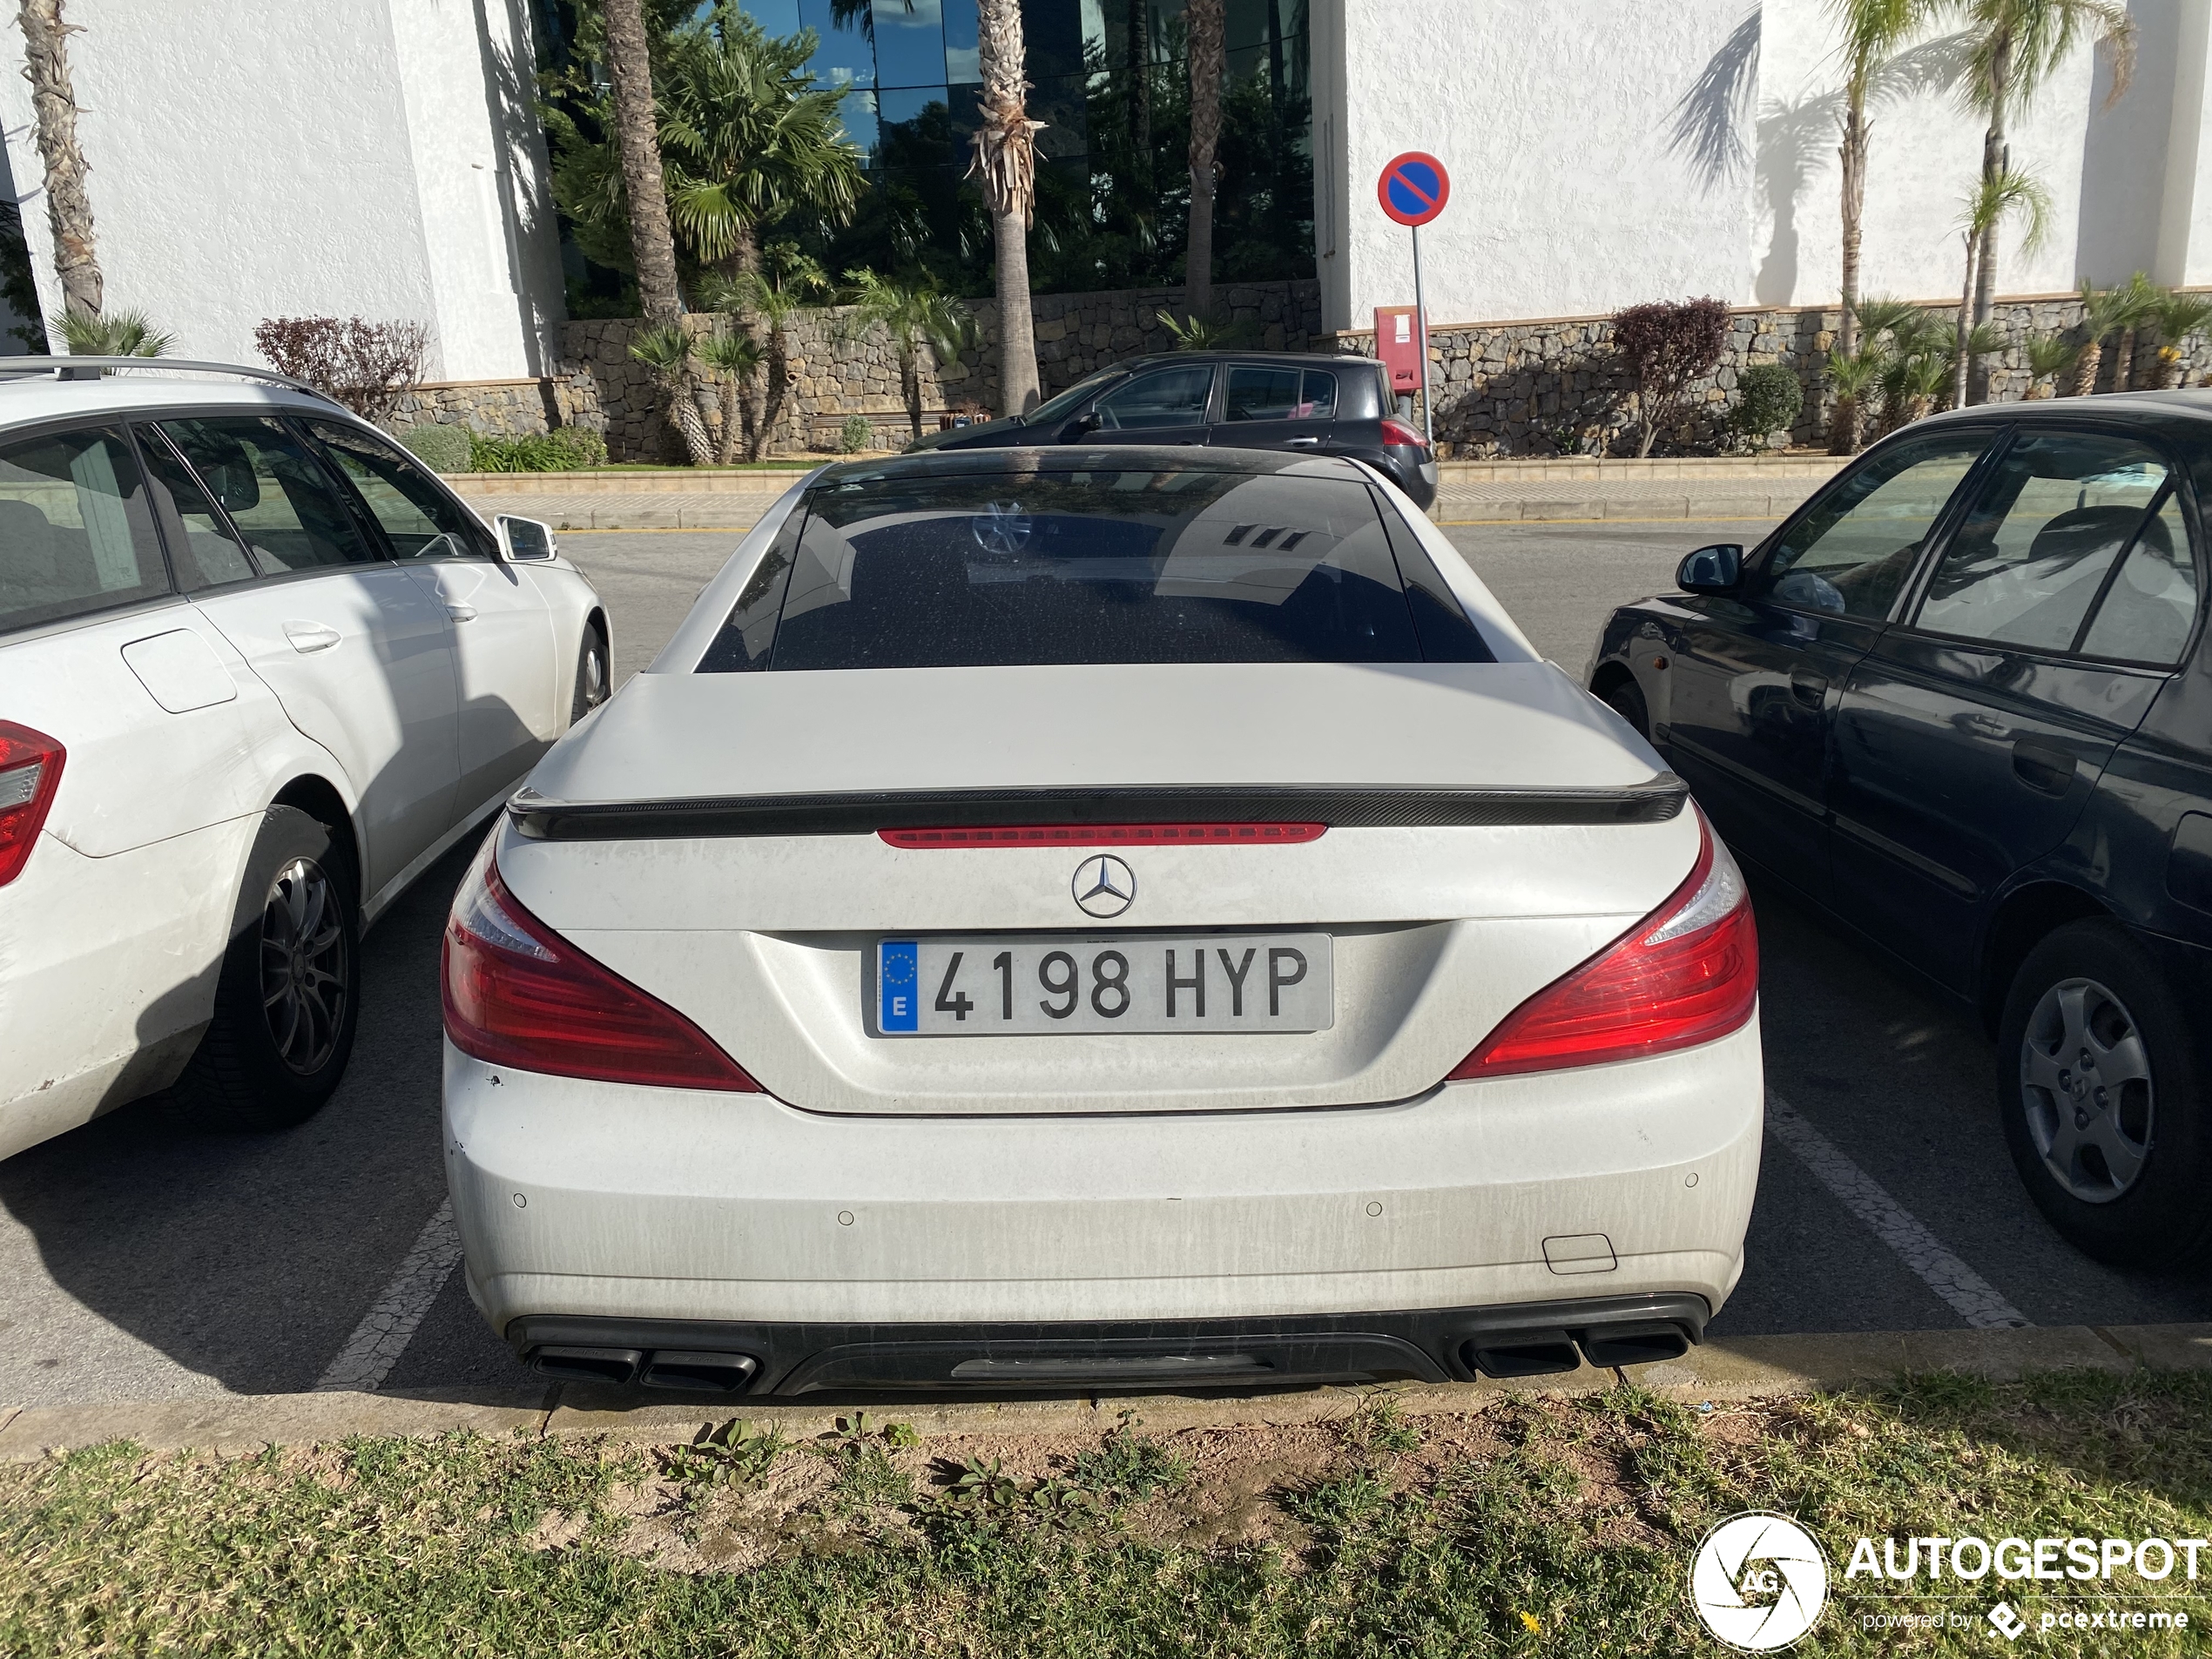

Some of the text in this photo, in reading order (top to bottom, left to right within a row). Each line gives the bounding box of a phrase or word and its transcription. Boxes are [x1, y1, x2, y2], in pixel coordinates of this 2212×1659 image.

[893, 996, 907, 1015] E
[935, 948, 1307, 1021] 4198 HYP
